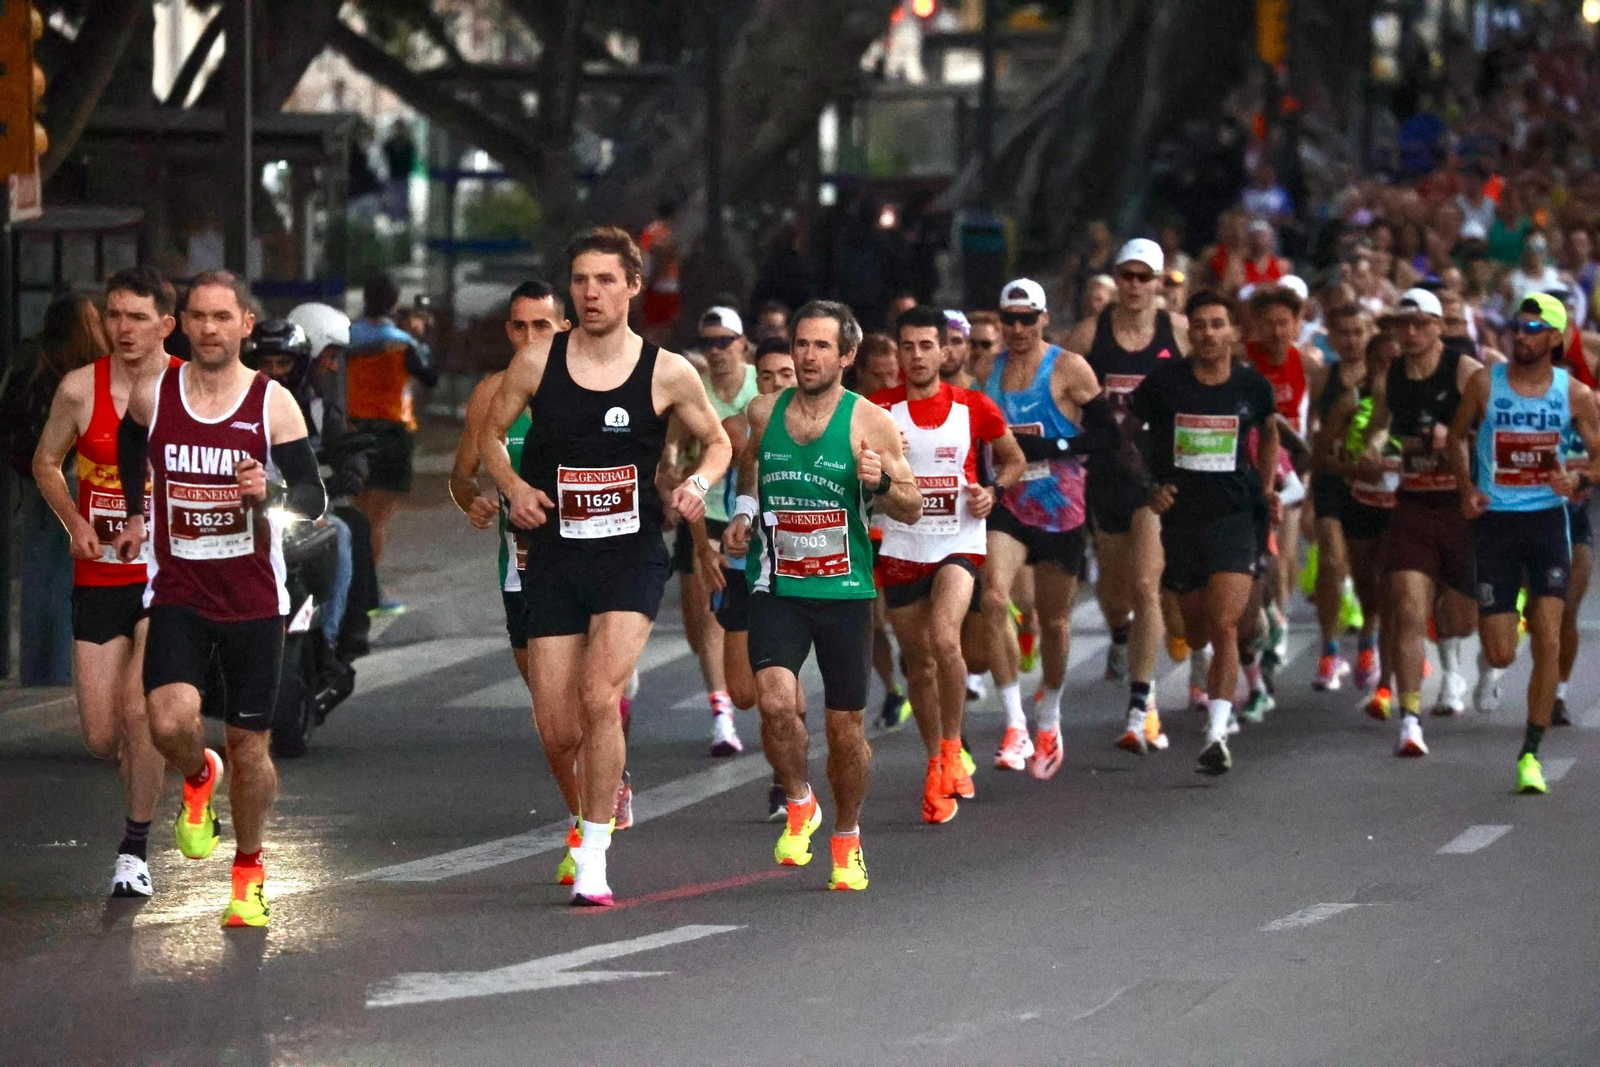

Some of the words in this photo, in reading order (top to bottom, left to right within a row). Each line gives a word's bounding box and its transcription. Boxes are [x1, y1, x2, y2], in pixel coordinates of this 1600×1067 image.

[1496, 409, 1561, 430] nerja
[579, 470, 630, 482] GENERALI
[187, 489, 240, 500] GENERAL
[575, 493, 621, 507] 11626
[768, 496, 839, 508] ATLETISMO
[183, 512, 234, 526] 13623
[791, 513, 840, 525] GENERALI
[791, 535, 827, 548] 7903
